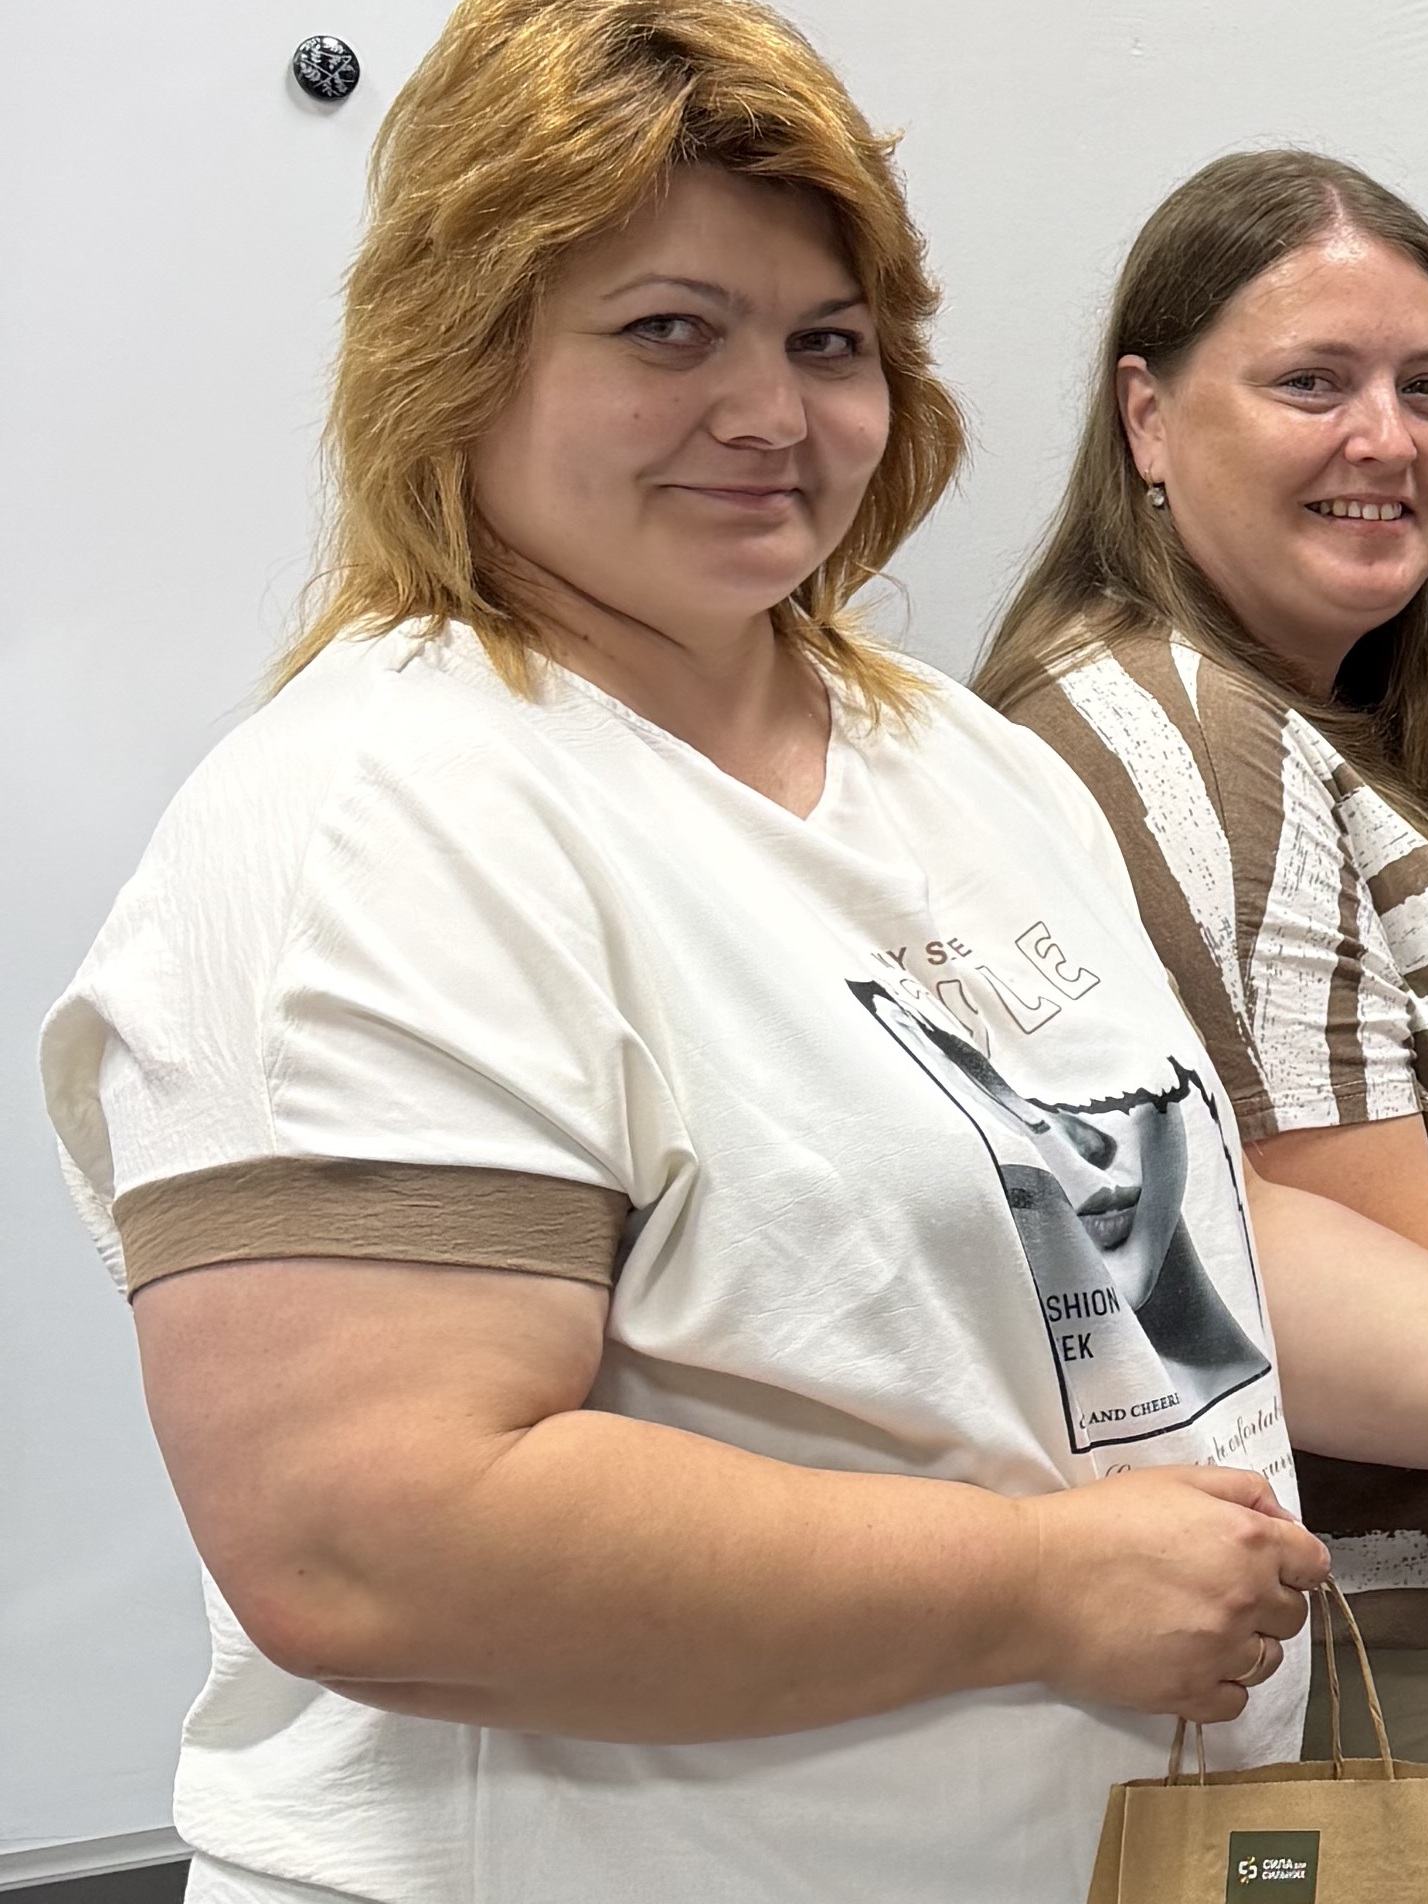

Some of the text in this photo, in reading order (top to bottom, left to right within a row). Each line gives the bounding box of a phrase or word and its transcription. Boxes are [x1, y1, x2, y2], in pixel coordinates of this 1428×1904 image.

[1046, 1286, 1121, 1323] SHION
[1061, 1332, 1095, 1362] EK
[1088, 1408, 1127, 1424] AND
